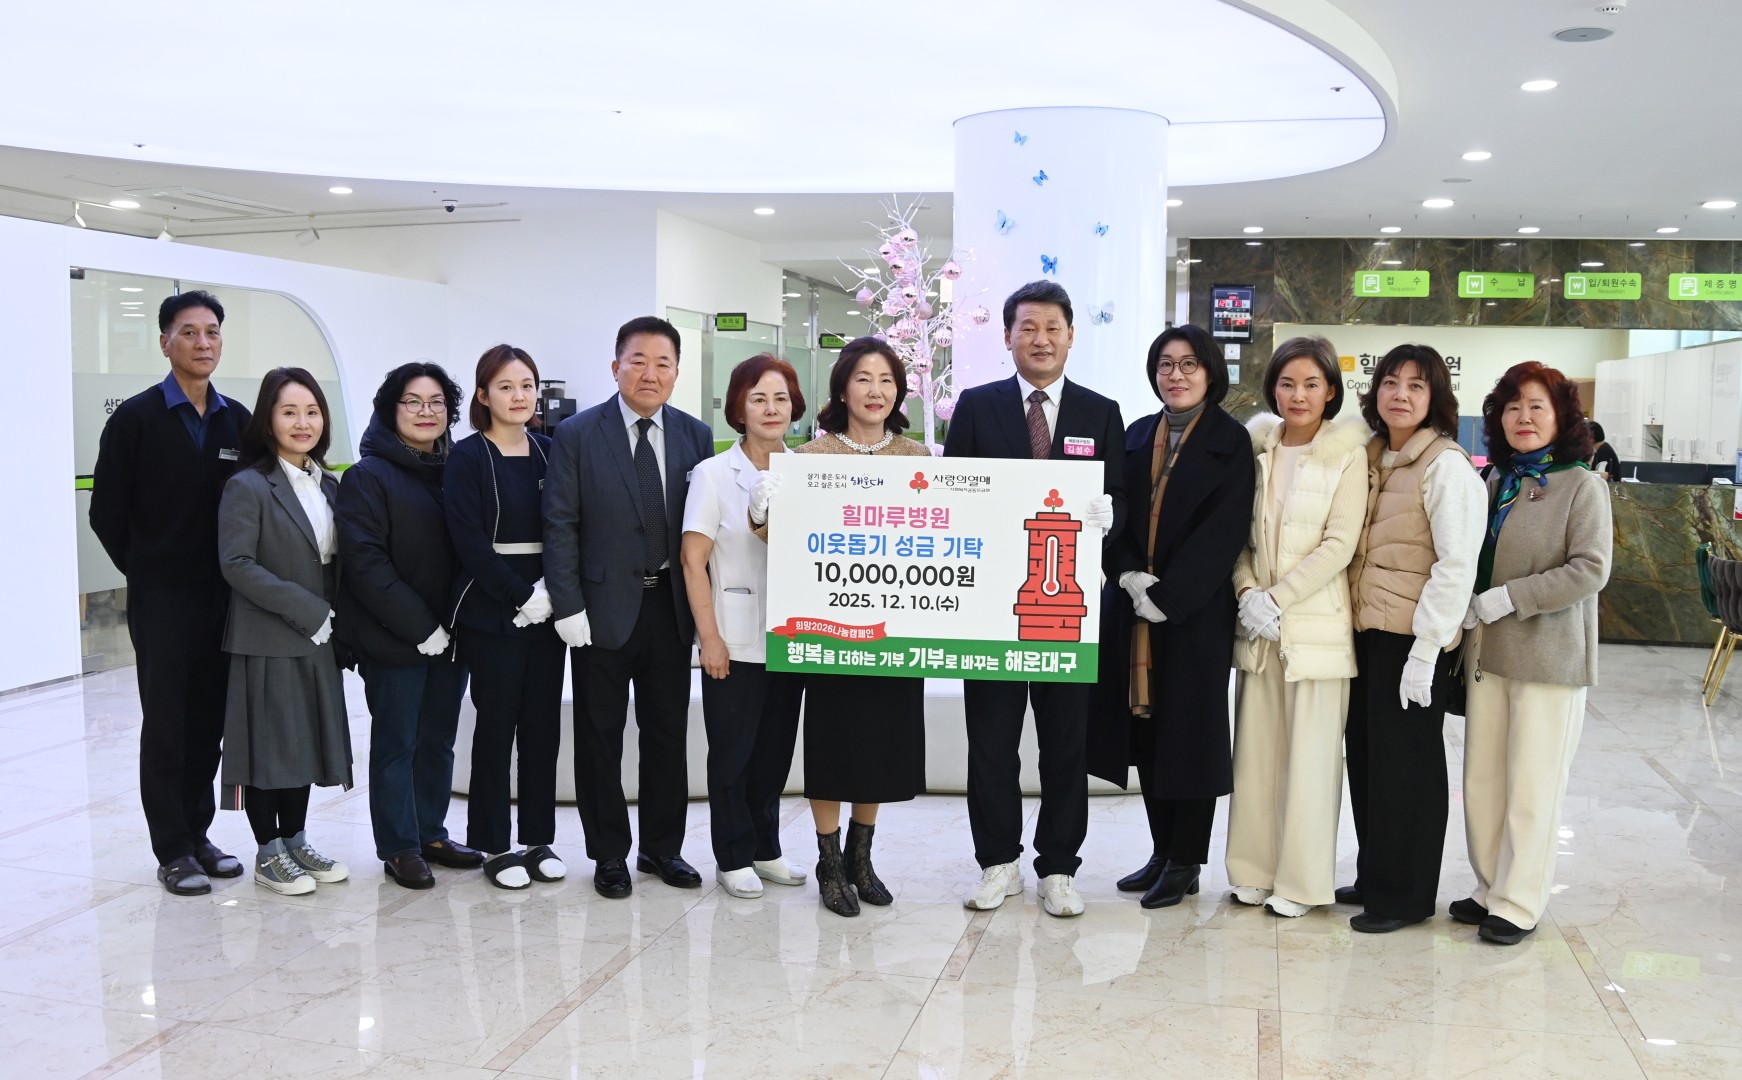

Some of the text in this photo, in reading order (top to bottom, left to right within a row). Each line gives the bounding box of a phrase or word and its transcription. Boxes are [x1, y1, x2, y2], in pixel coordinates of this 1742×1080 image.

[1588, 278, 1637, 288] 입/퇴원수속
[932, 474, 991, 487] 사랑의열매
[842, 505, 949, 529] 힐마루병원
[807, 533, 984, 559] 이웃돕기 성금 기탁
[814, 561, 975, 588] 10,000,000원
[828, 592, 960, 612] 2025. 12. 10.(수)
[795, 620, 875, 639] 희망2026나눔캠페인
[787, 641, 1077, 673] 행복을 더하는 기부 기부로 바꾸는 해운대구
